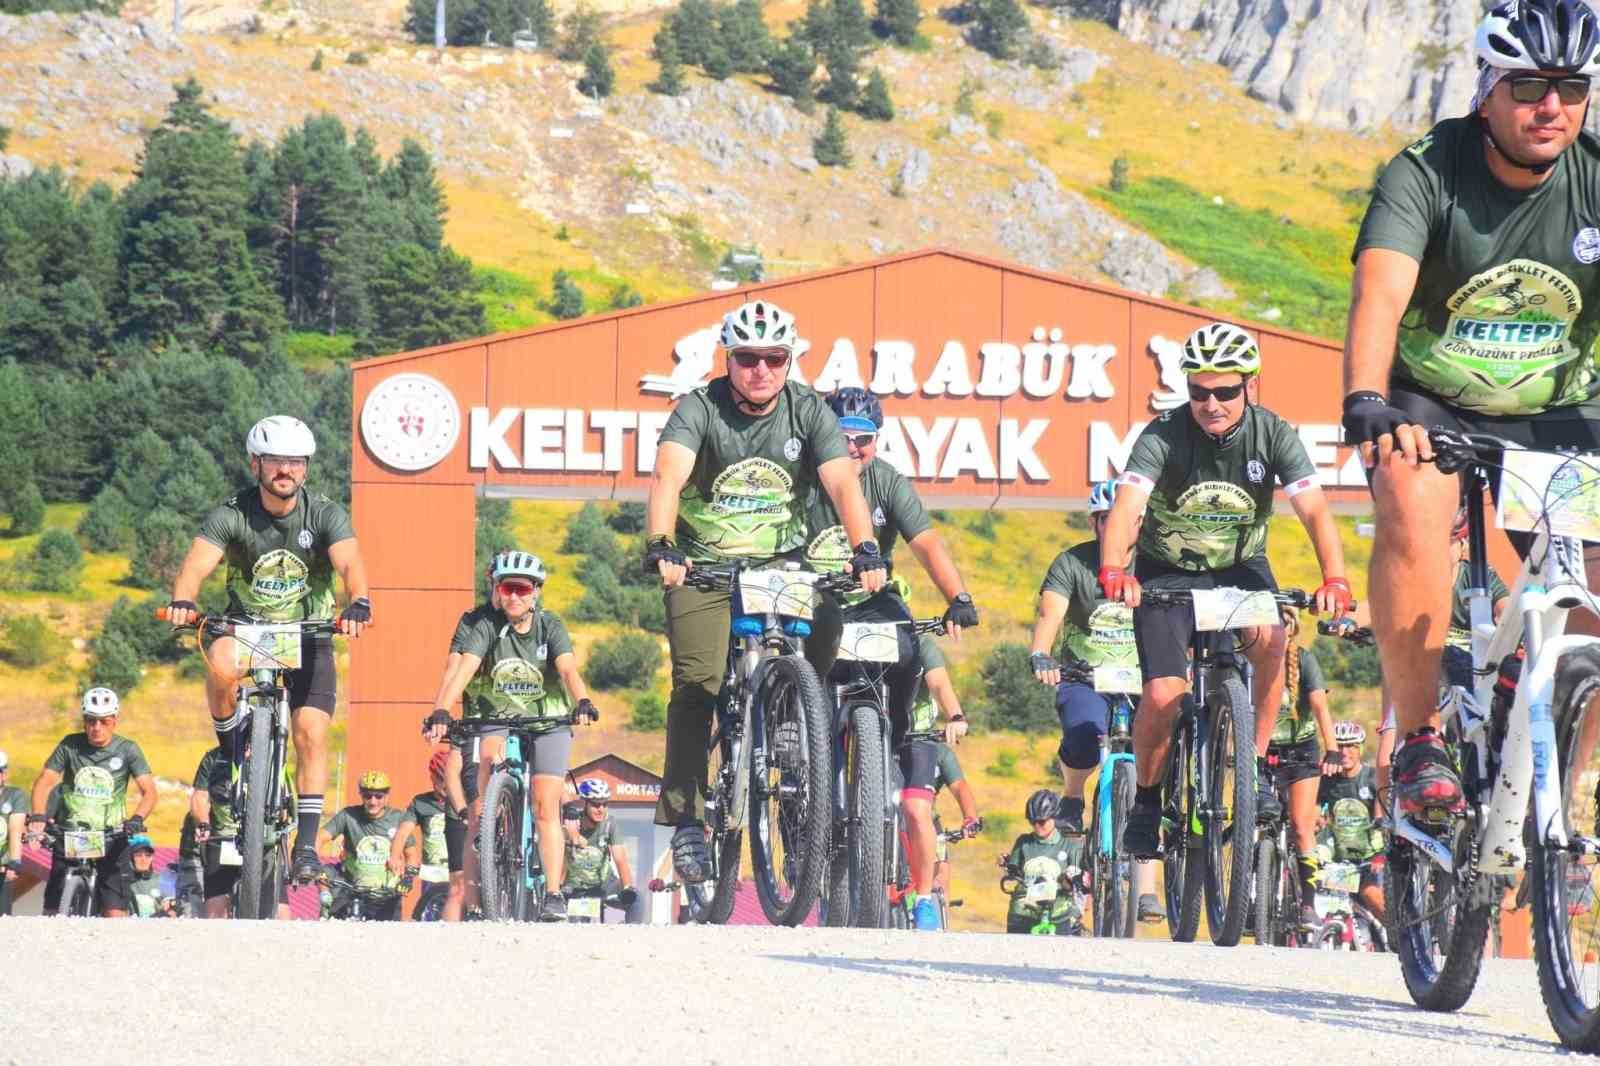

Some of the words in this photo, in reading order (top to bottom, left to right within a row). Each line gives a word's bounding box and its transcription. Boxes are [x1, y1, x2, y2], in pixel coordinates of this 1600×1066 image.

[470, 406, 673, 473] KELTE
[876, 416, 1052, 481] AYAK
[616, 783, 662, 797] NOKTAS
